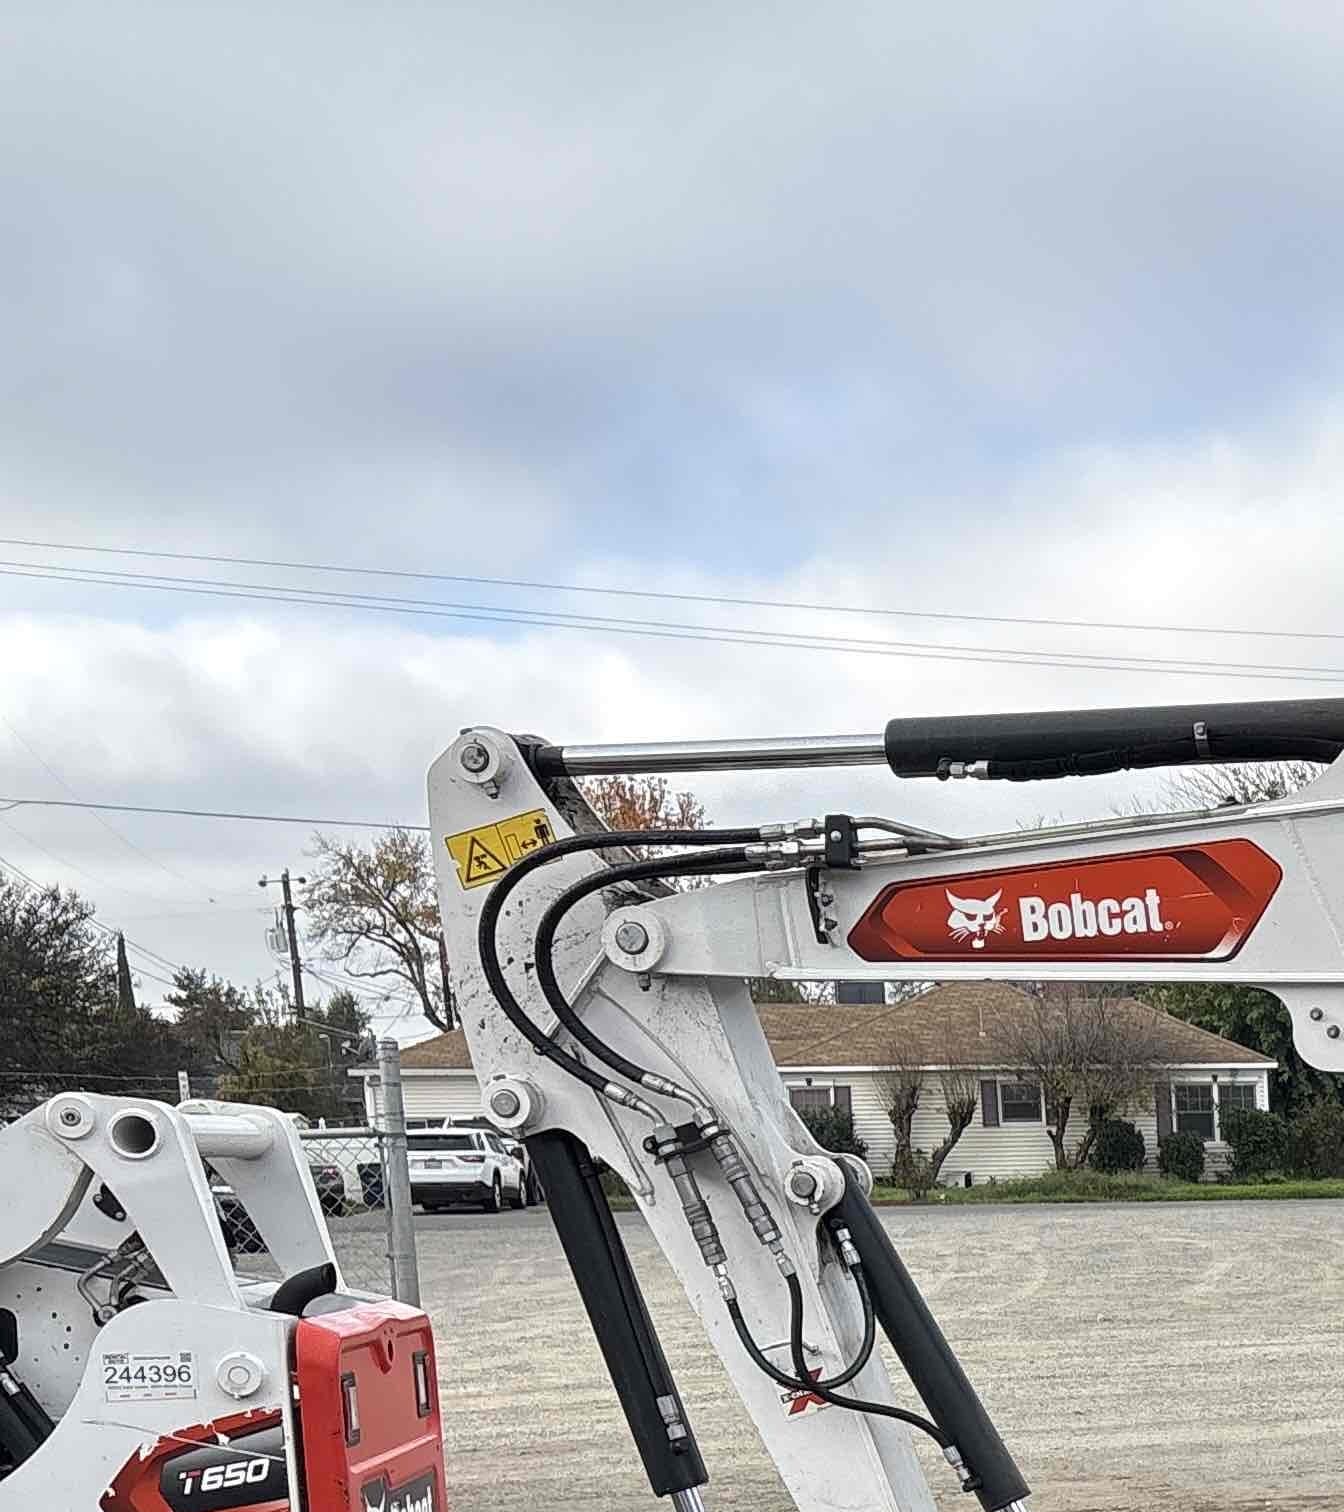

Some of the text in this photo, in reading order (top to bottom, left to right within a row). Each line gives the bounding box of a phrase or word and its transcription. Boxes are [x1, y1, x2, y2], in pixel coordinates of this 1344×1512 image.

[1019, 888, 1164, 942] Bobcat
[103, 1364, 192, 1385] 244396
[178, 1458, 270, 1495] T650
